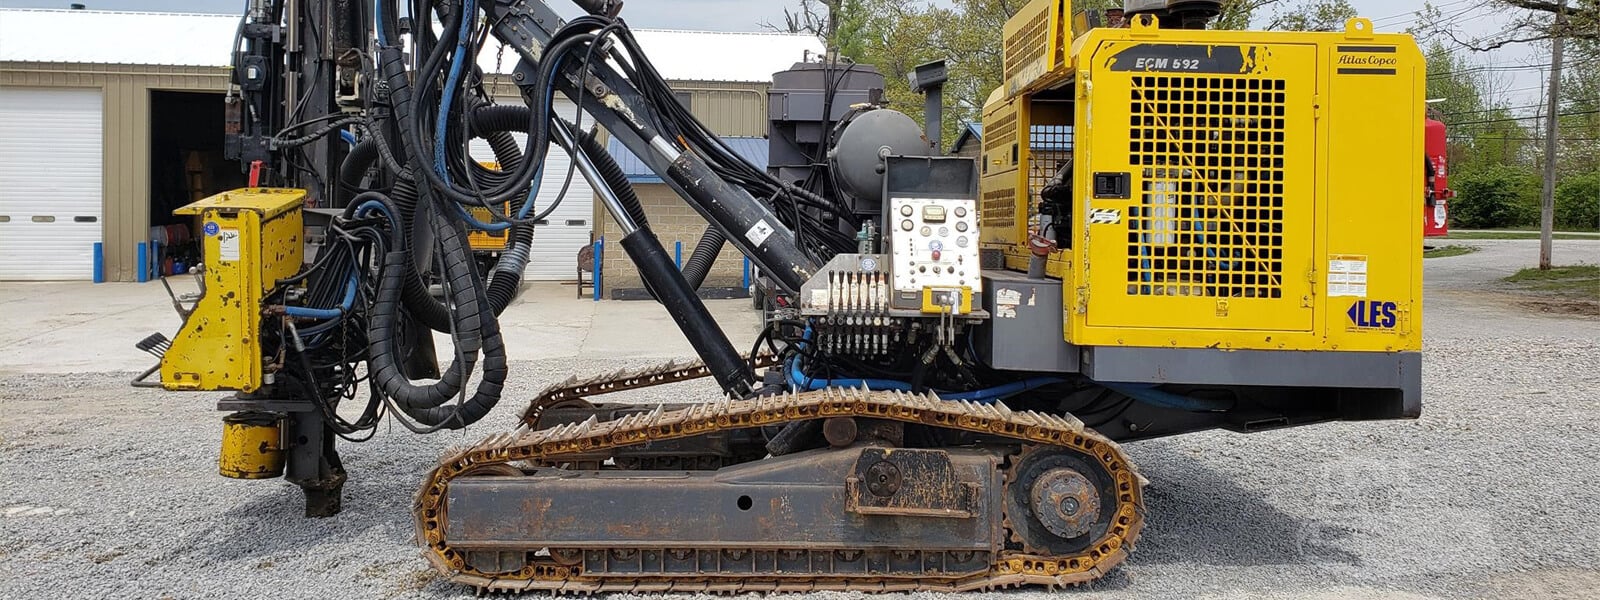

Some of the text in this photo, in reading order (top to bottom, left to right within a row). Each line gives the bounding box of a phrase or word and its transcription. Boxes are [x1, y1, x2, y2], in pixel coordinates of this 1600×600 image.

[1135, 57, 1167, 69] ECM
[1338, 55, 1397, 66] Atlas Copco
[1357, 300, 1396, 328] LES
